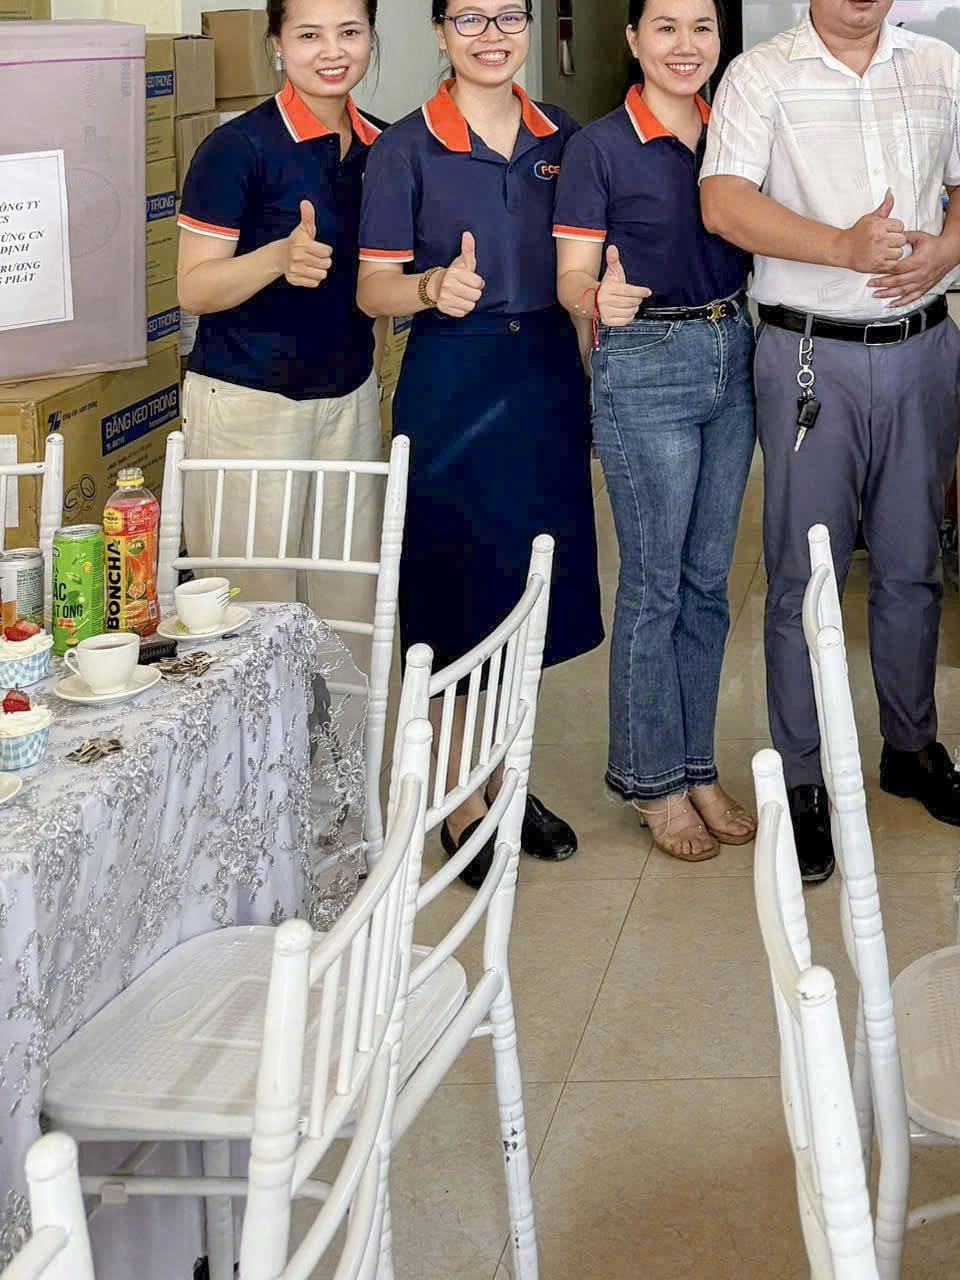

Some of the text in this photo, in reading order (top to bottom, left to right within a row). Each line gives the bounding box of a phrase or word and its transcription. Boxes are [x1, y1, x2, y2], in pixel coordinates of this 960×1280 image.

[0, 201, 24, 212] ÔNG
[0, 260, 41, 273] RƯƠNG
[105, 412, 132, 440] BĂNG
[148, 389, 178, 417] TRONG
[106, 540, 122, 631] BONCHA
